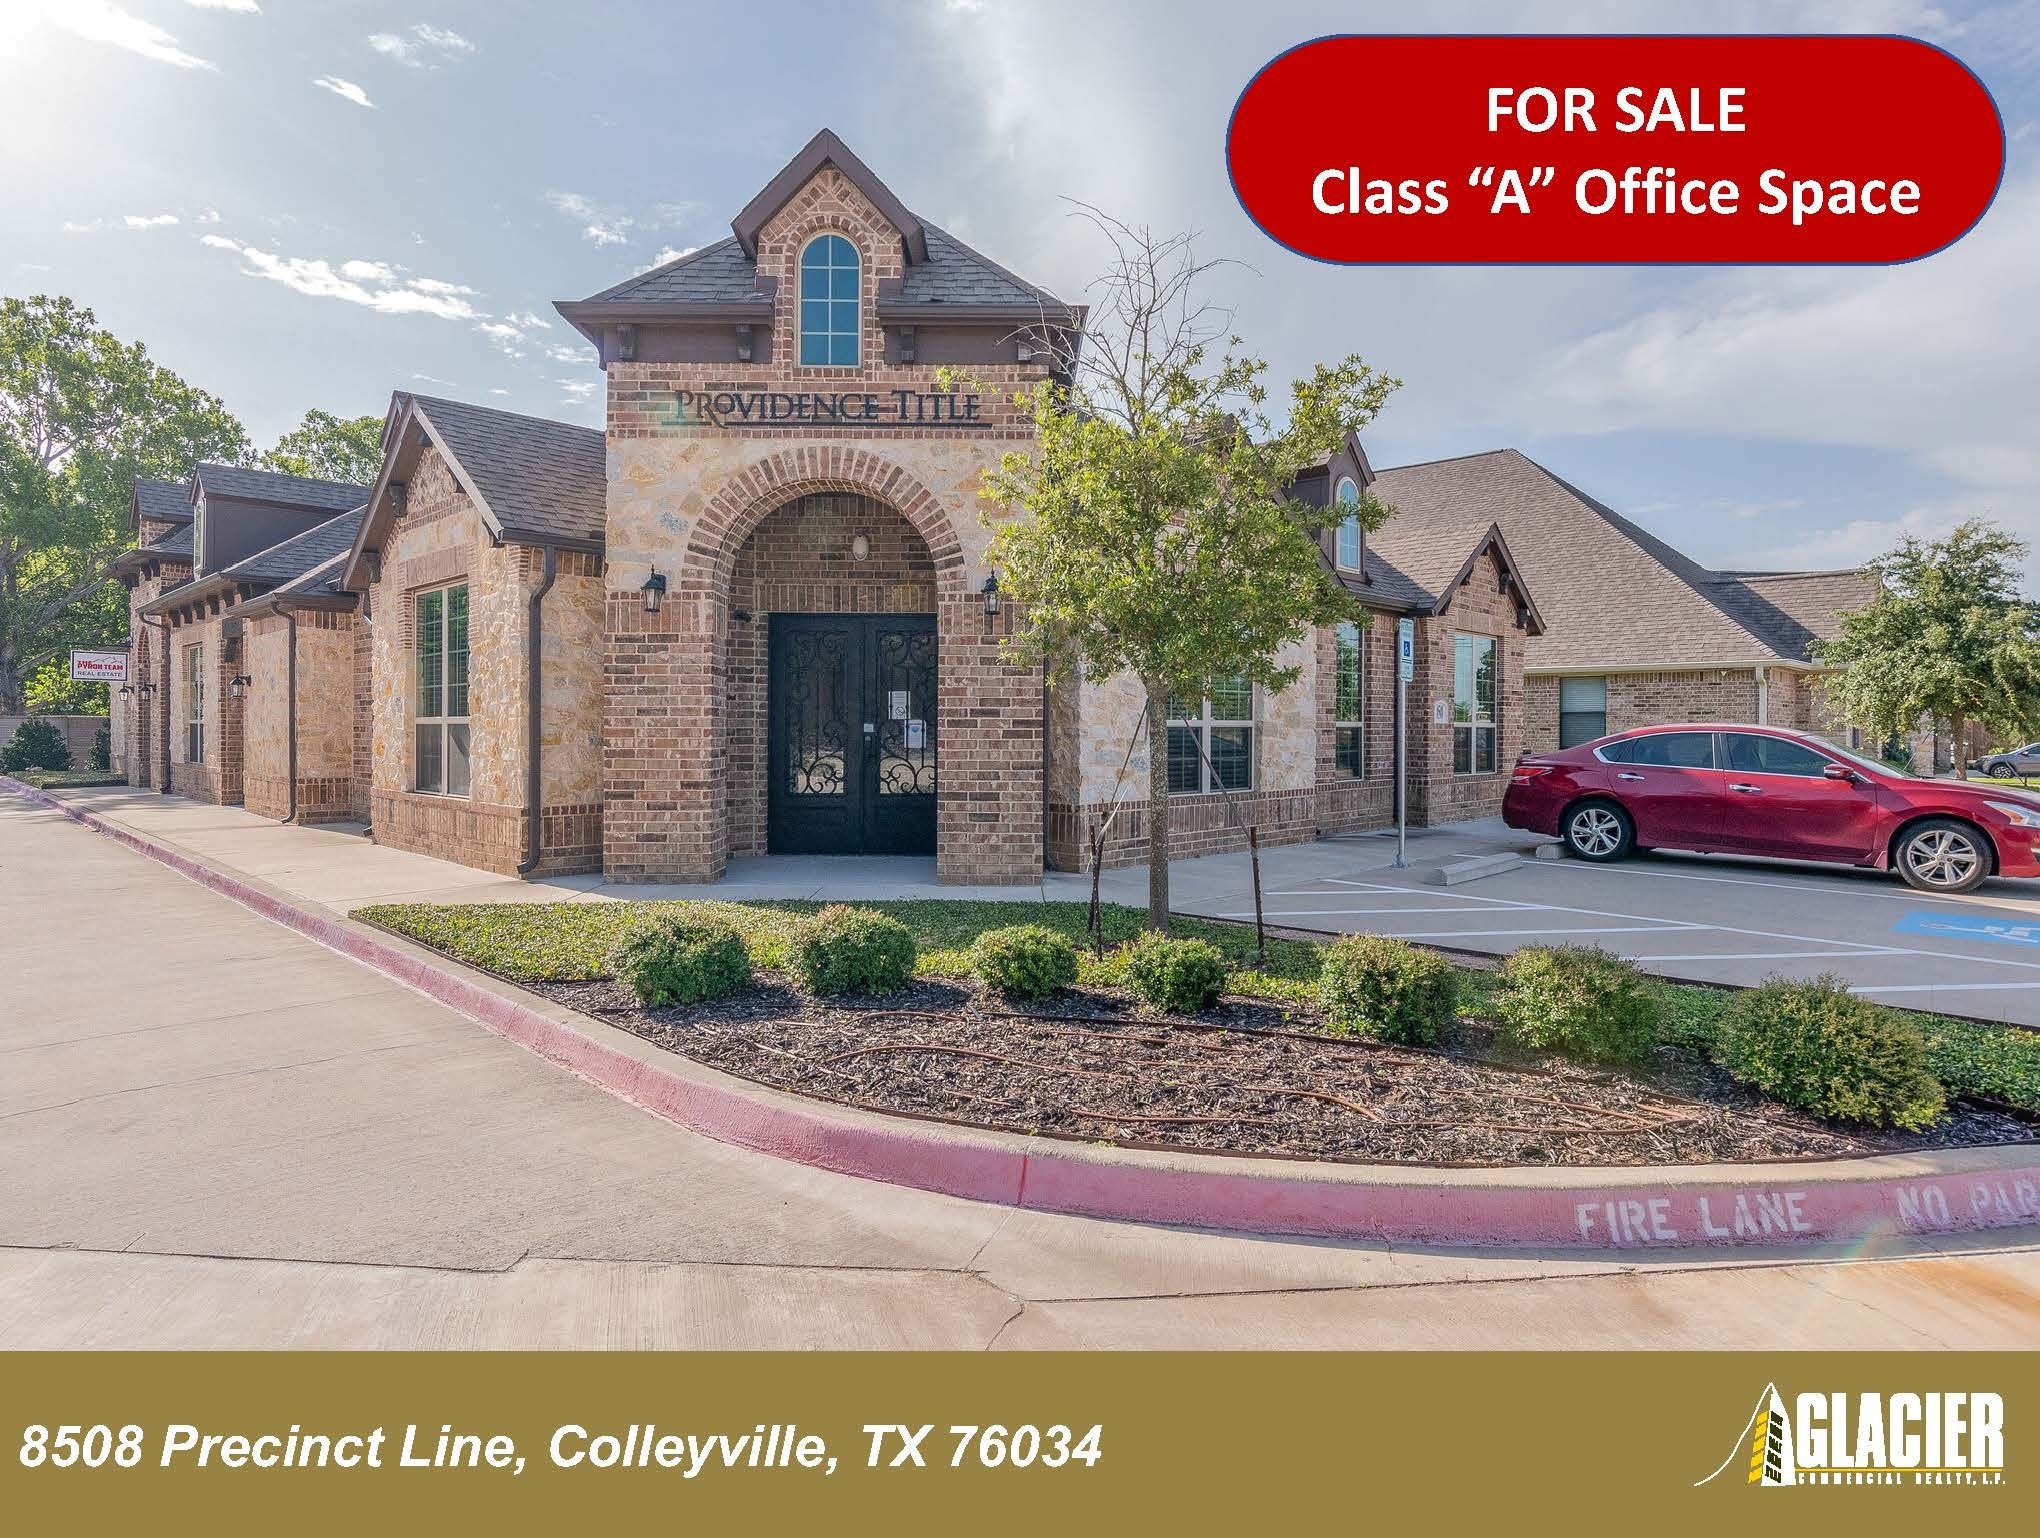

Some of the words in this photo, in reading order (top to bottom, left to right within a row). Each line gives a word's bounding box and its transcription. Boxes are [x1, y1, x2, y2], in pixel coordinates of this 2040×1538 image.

[1574, 1198, 1677, 1243] FIRE
[1700, 1192, 1813, 1238] LANE
[1896, 1185, 1952, 1228] NO
